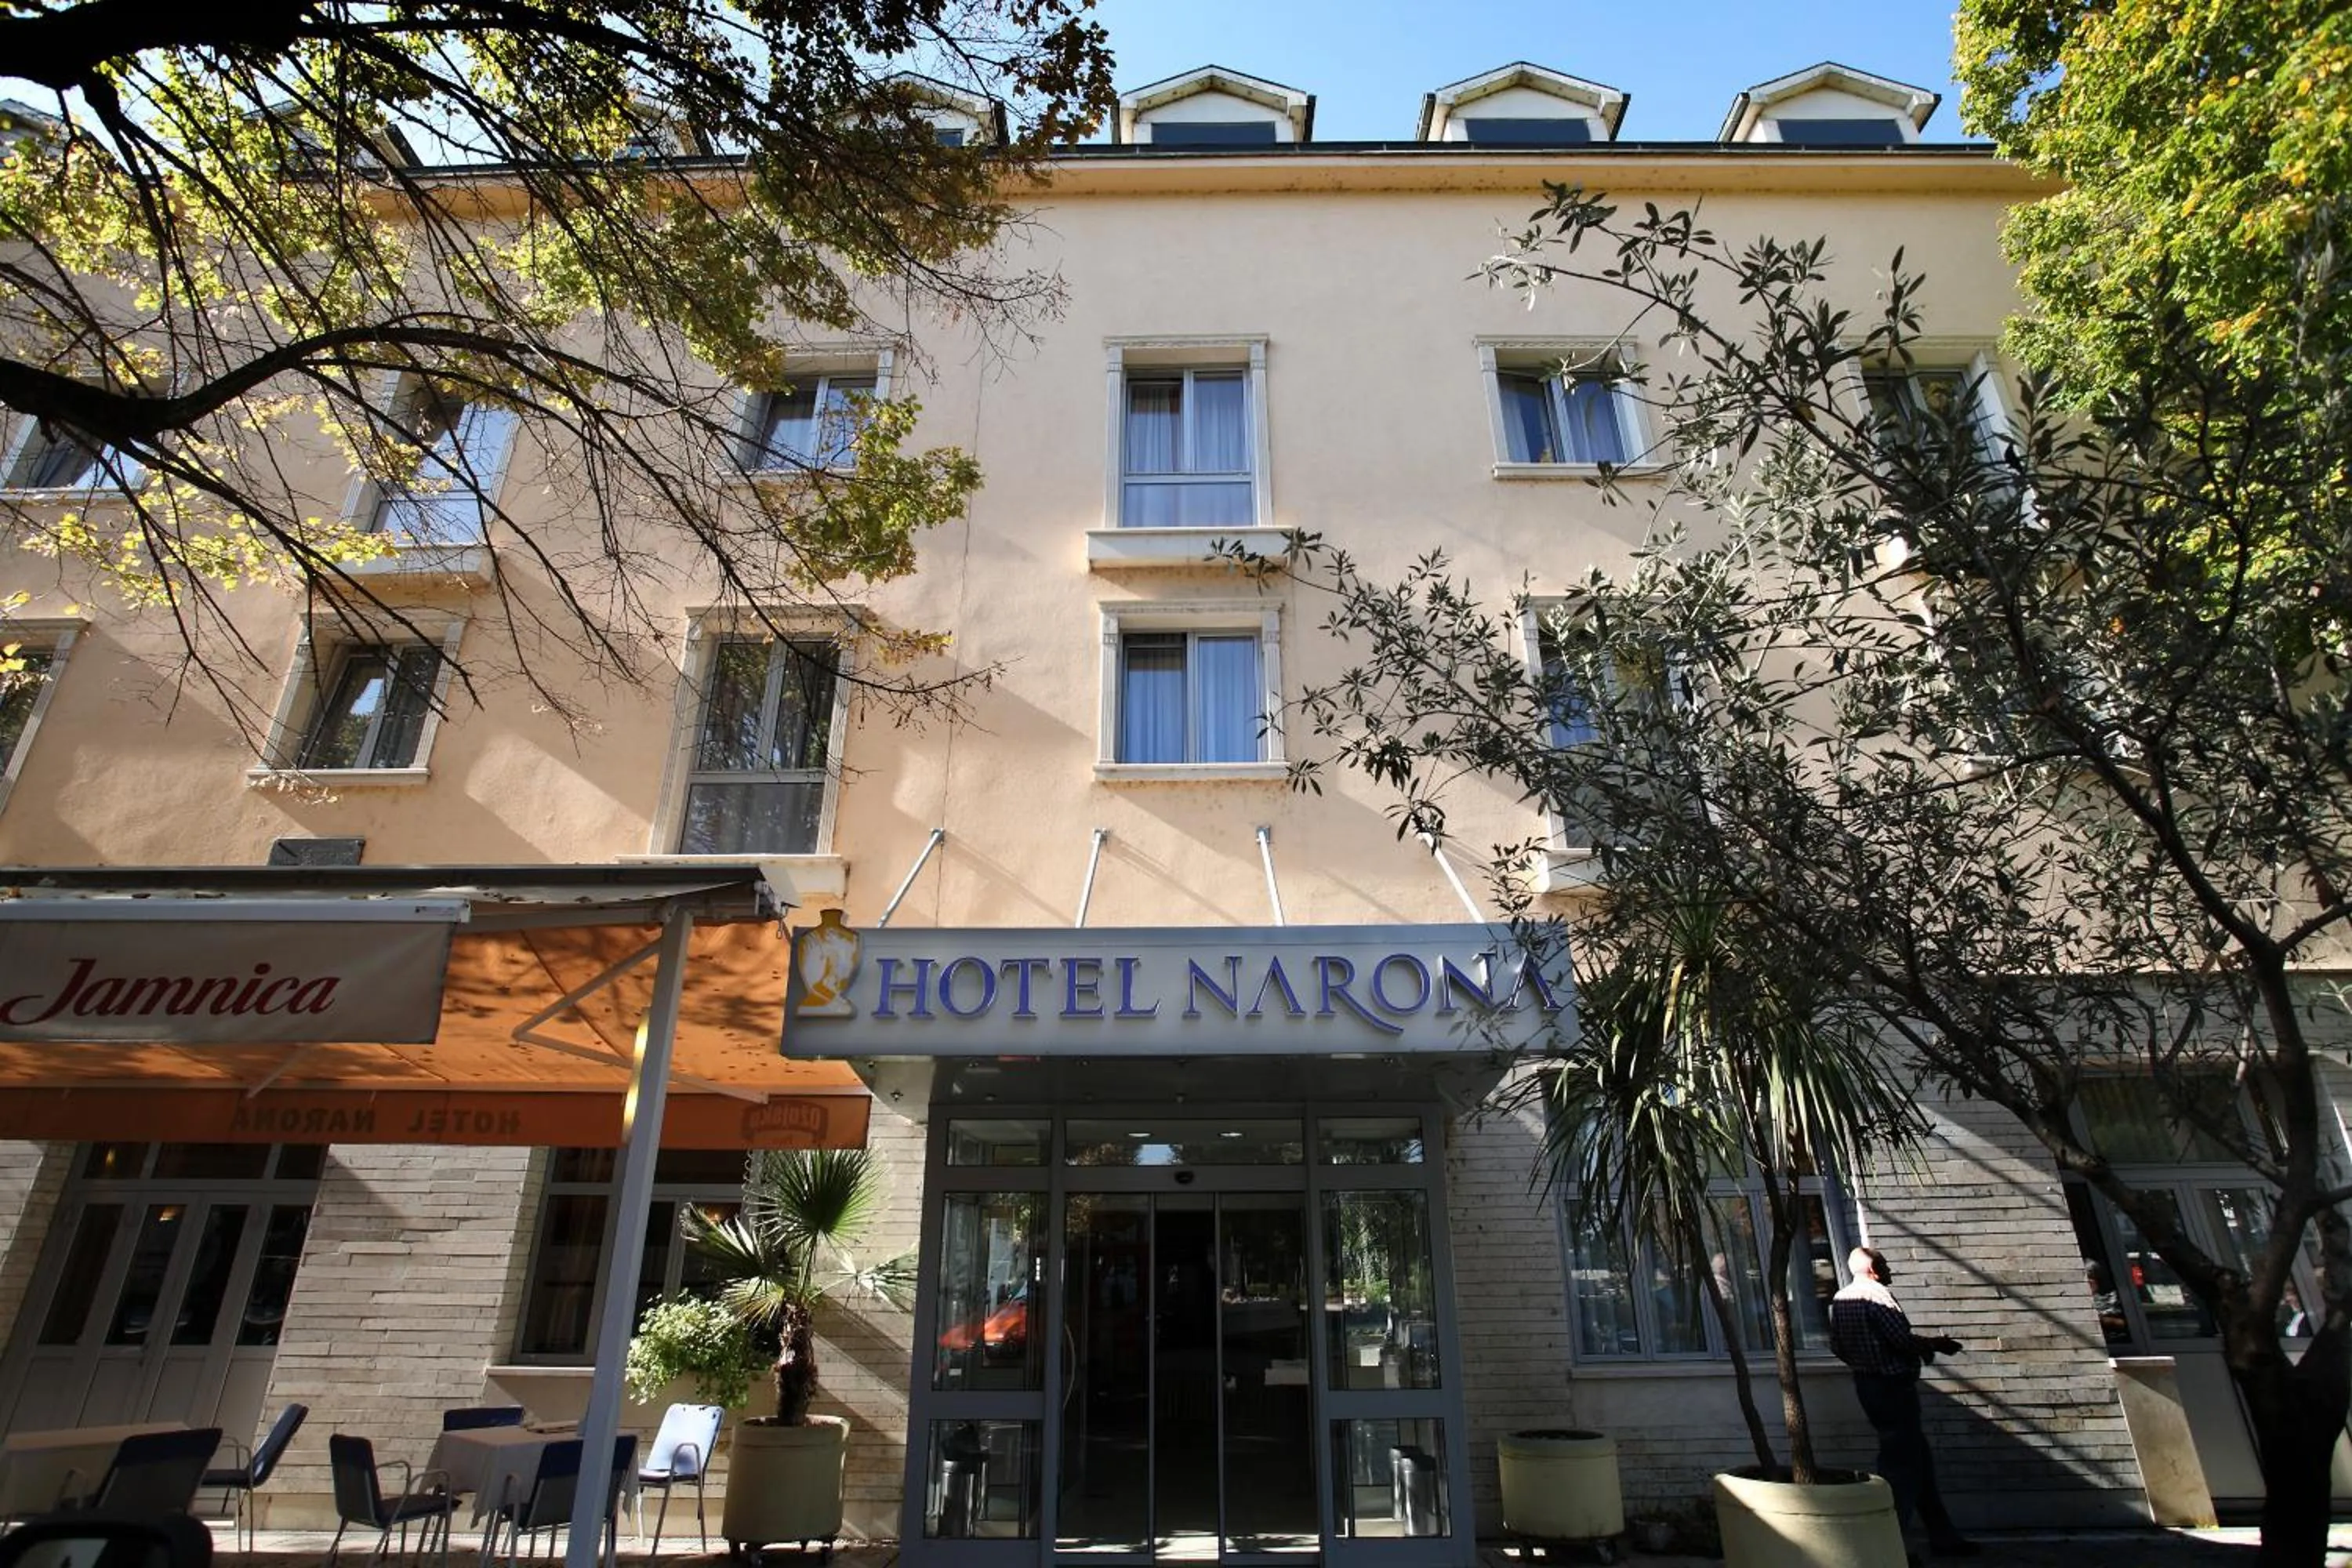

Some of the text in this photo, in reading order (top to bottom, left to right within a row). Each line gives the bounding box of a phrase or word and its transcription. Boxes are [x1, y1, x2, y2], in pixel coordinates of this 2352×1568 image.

[0, 958, 342, 1026] Jamnica
[871, 952, 1563, 1035] HOTEL NARONA
